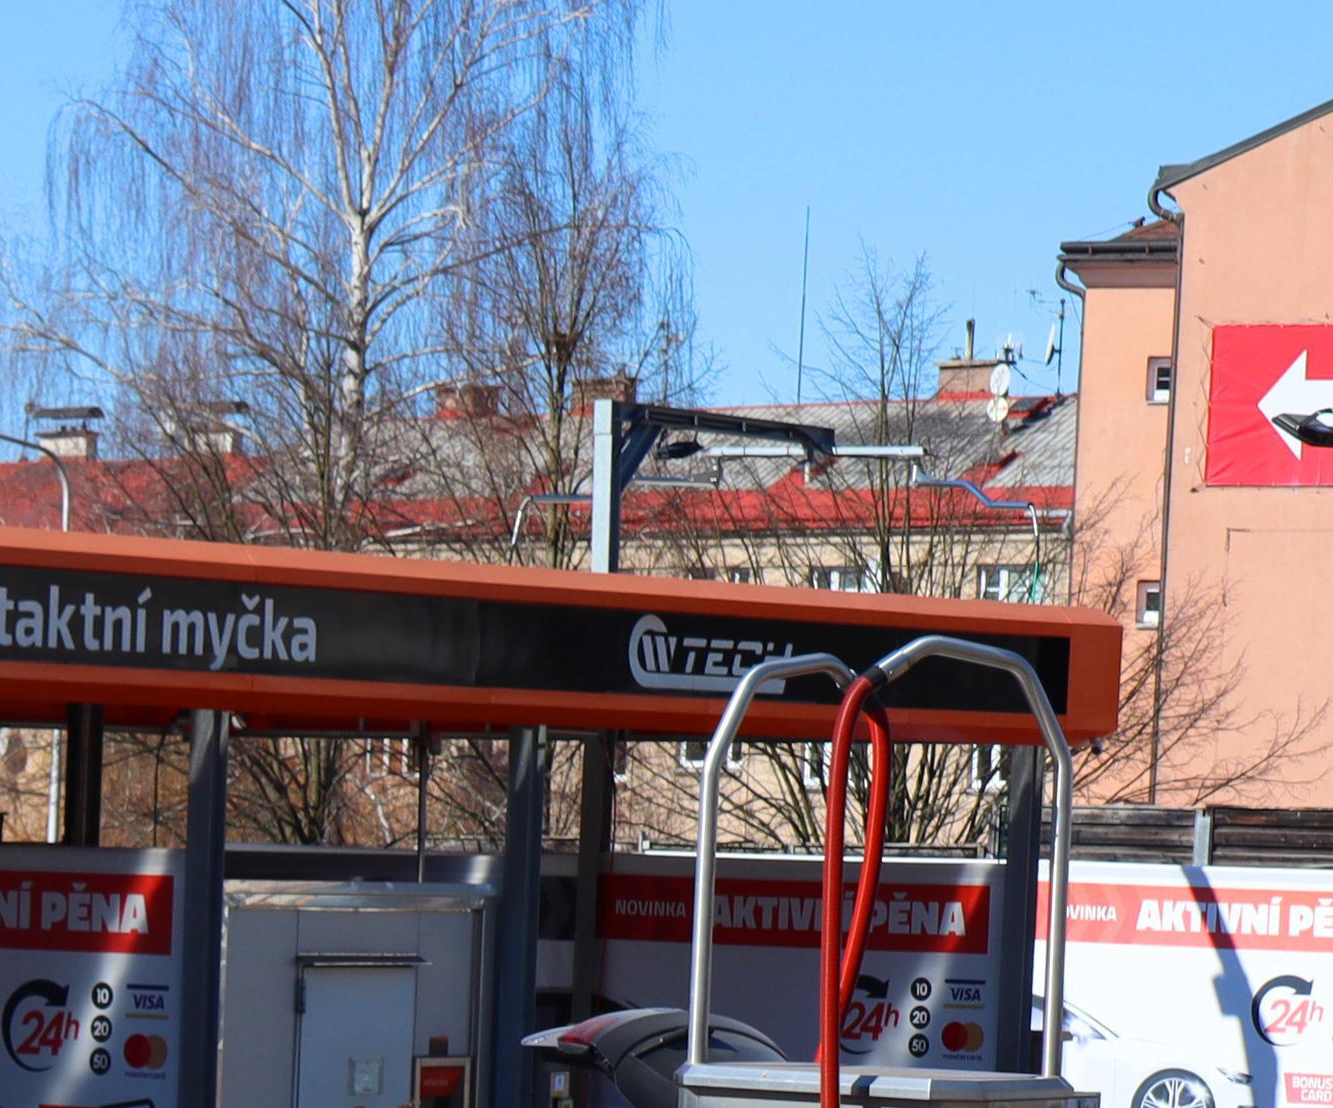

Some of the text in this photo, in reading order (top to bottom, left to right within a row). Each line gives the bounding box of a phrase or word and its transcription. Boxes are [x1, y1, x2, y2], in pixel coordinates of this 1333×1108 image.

[161, 593, 318, 671] myčka
[40, 882, 149, 935] PĚNA
[615, 898, 686, 918] NOVINKA
[1066, 904, 1117, 921] VINKA
[1135, 896, 1283, 936] AKTIVNÍ
[95, 988, 109, 1003] 10
[915, 983, 928, 996] 10
[950, 987, 981, 1001] VISA
[132, 994, 164, 1010] VISA
[841, 1002, 900, 1041] 24h
[912, 1011, 928, 1024] 20
[1264, 999, 1324, 1034] 24h
[16, 1010, 80, 1056] 24h
[93, 1022, 109, 1037] 20
[911, 1039, 927, 1053] 50
[92, 1054, 108, 1069] 50
[1292, 1076, 1333, 1090] BONUS
[1301, 1089, 1332, 1102] CARD
